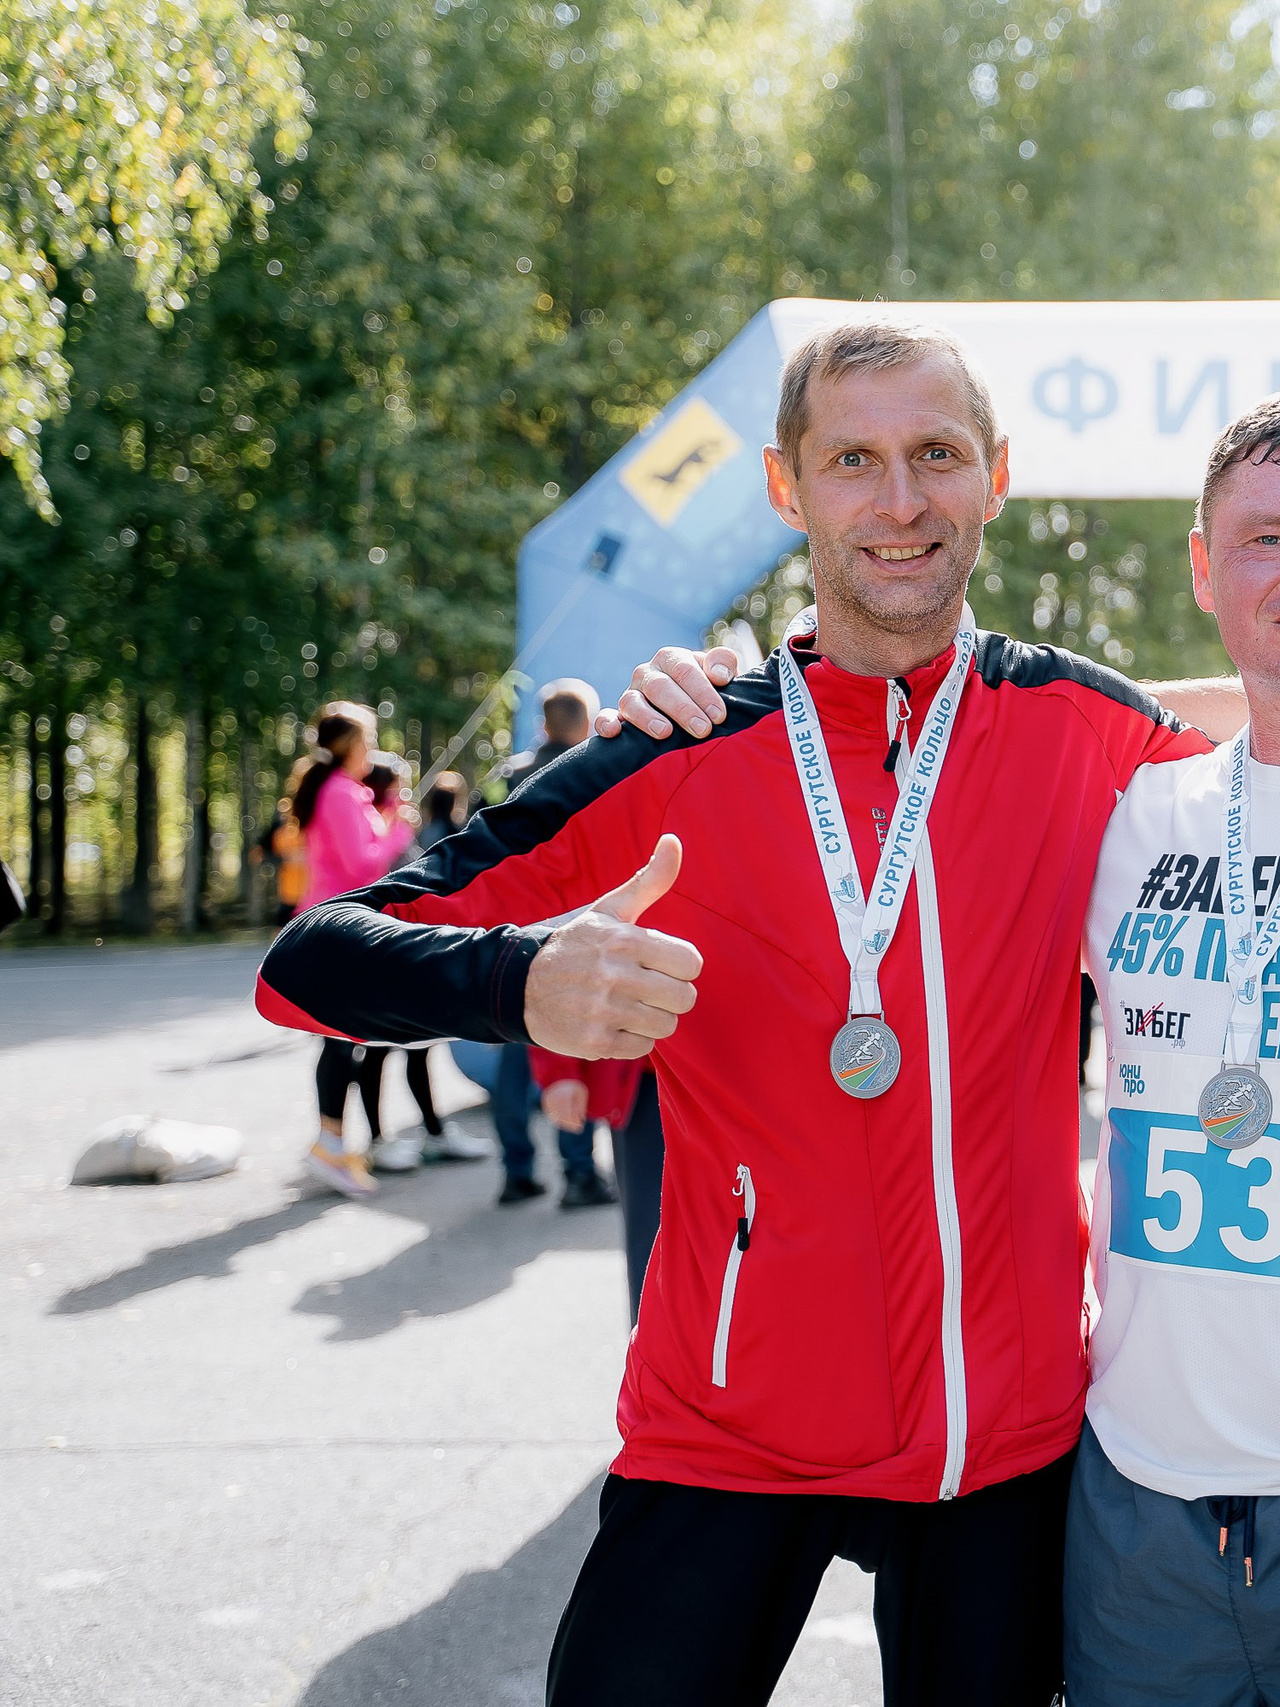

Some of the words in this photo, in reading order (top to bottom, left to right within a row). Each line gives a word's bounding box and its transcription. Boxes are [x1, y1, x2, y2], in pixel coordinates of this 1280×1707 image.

[780, 654, 808, 725] КОЛЬЦО
[795, 730, 841, 854] СУРГУТСКОЕ
[877, 782, 927, 907] СУРГУТСКОЕ
[916, 697, 951, 777] КОЛЬЦО
[957, 631, 972, 676] 2025
[1230, 739, 1244, 802] КОЛЬЦО
[1227, 805, 1246, 915] СУРГУТСКОЕ
[1107, 911, 1190, 977] 45%
